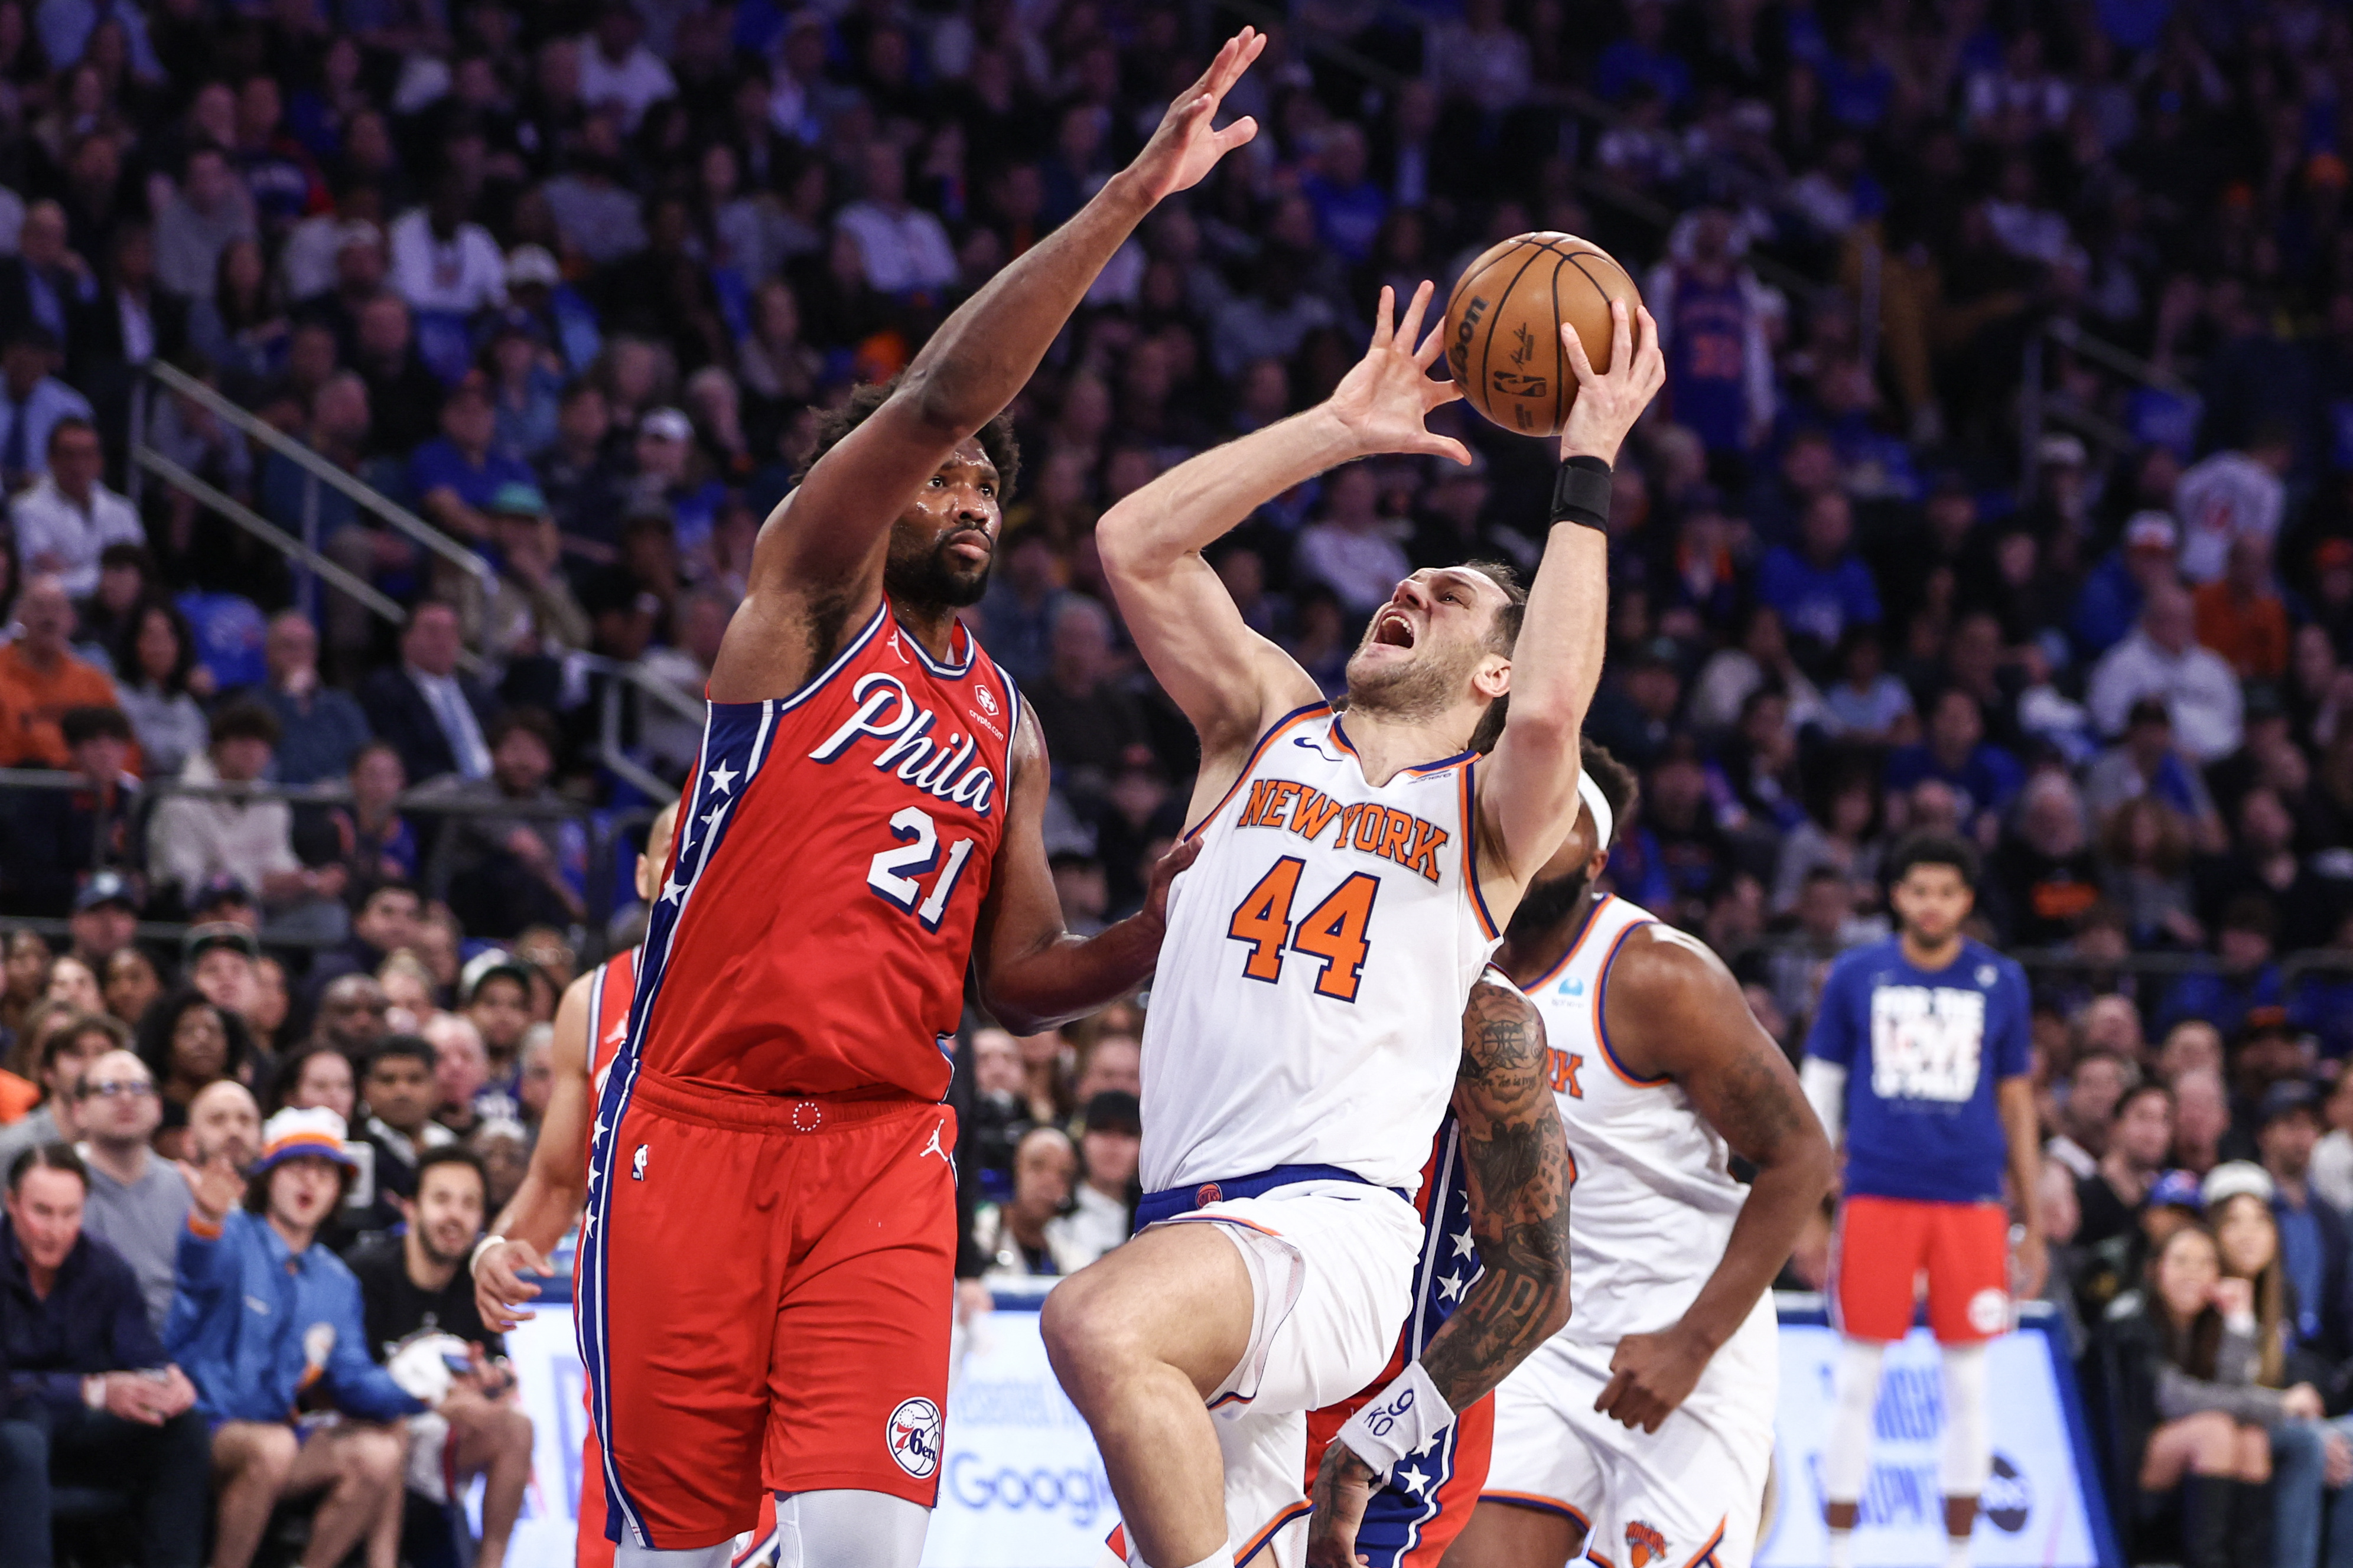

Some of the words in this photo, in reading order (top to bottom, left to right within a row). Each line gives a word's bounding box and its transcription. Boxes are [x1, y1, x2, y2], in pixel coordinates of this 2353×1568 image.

[808, 672, 995, 818] Phila
[969, 709, 1004, 742] crypto.com
[867, 806, 974, 934] 21
[1236, 779, 1343, 843] NEW
[1332, 801, 1450, 887] YORK
[1226, 854, 1382, 1004] 44
[894, 1422, 936, 1462] 76ers
